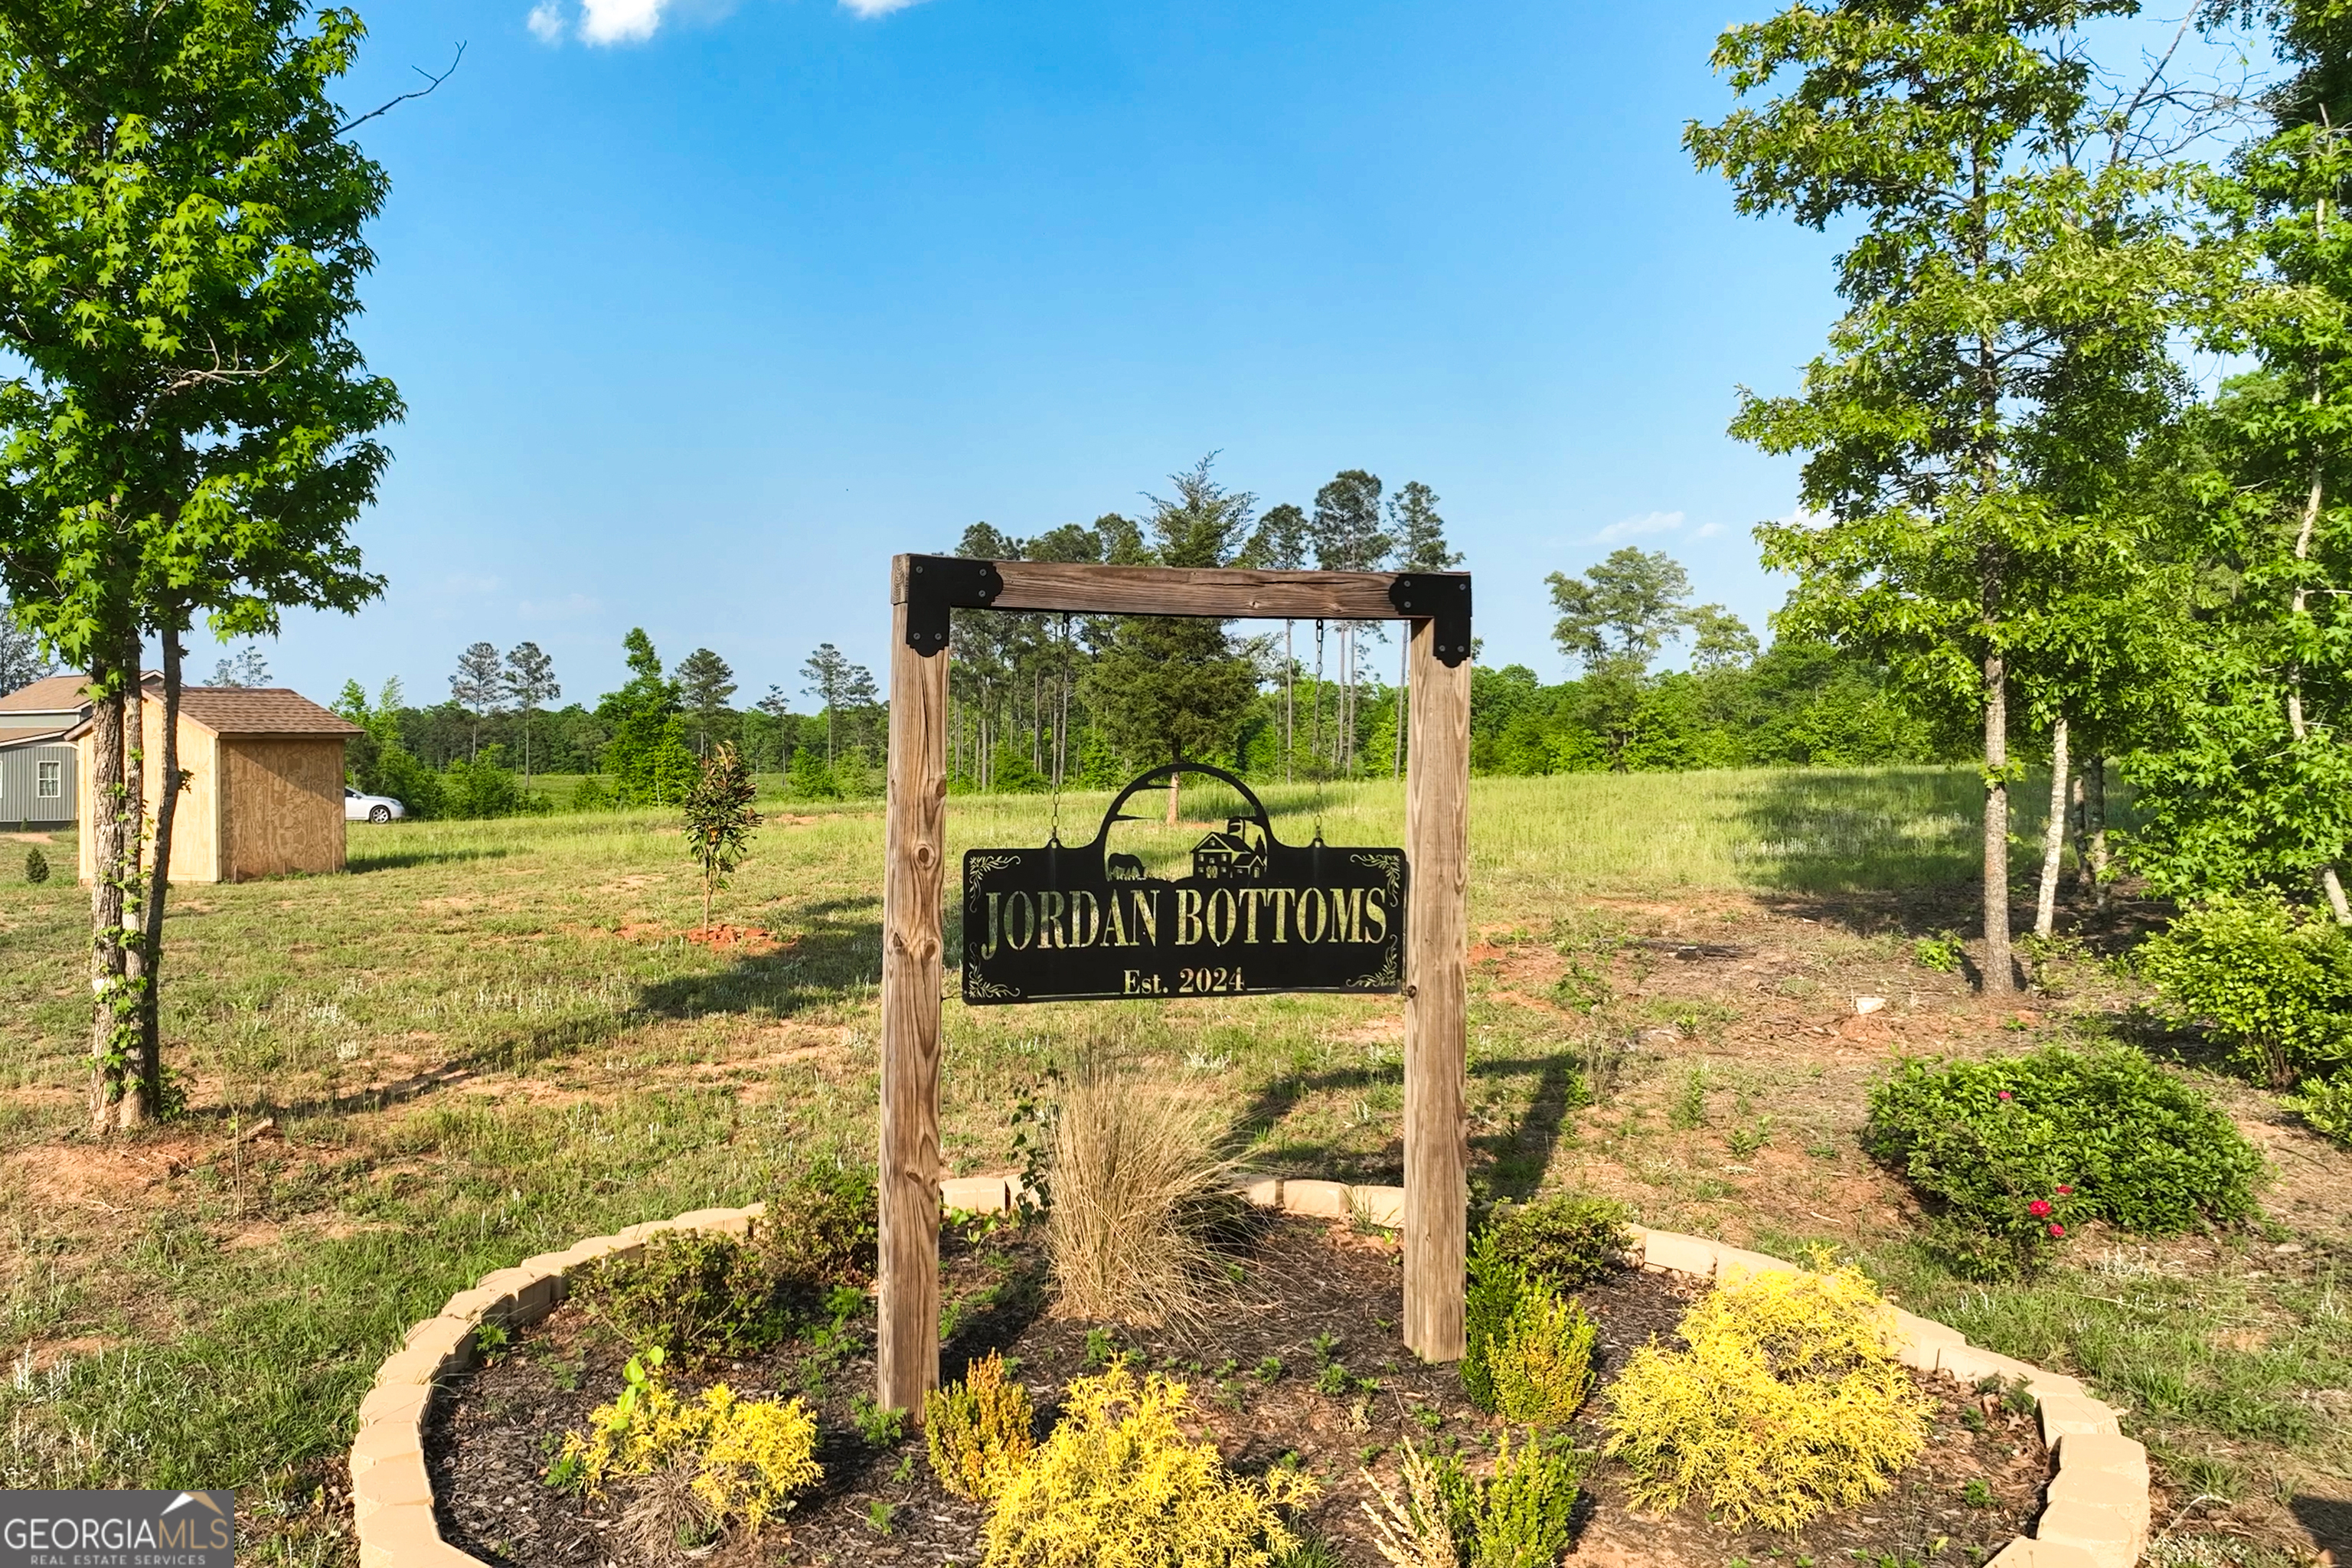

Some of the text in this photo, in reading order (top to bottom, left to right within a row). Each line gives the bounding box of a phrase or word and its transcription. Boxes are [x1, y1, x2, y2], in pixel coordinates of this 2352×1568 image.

[981, 887, 1387, 960] JORDAN BOTTOMS
[1123, 966, 1246, 995] Est. 2024
